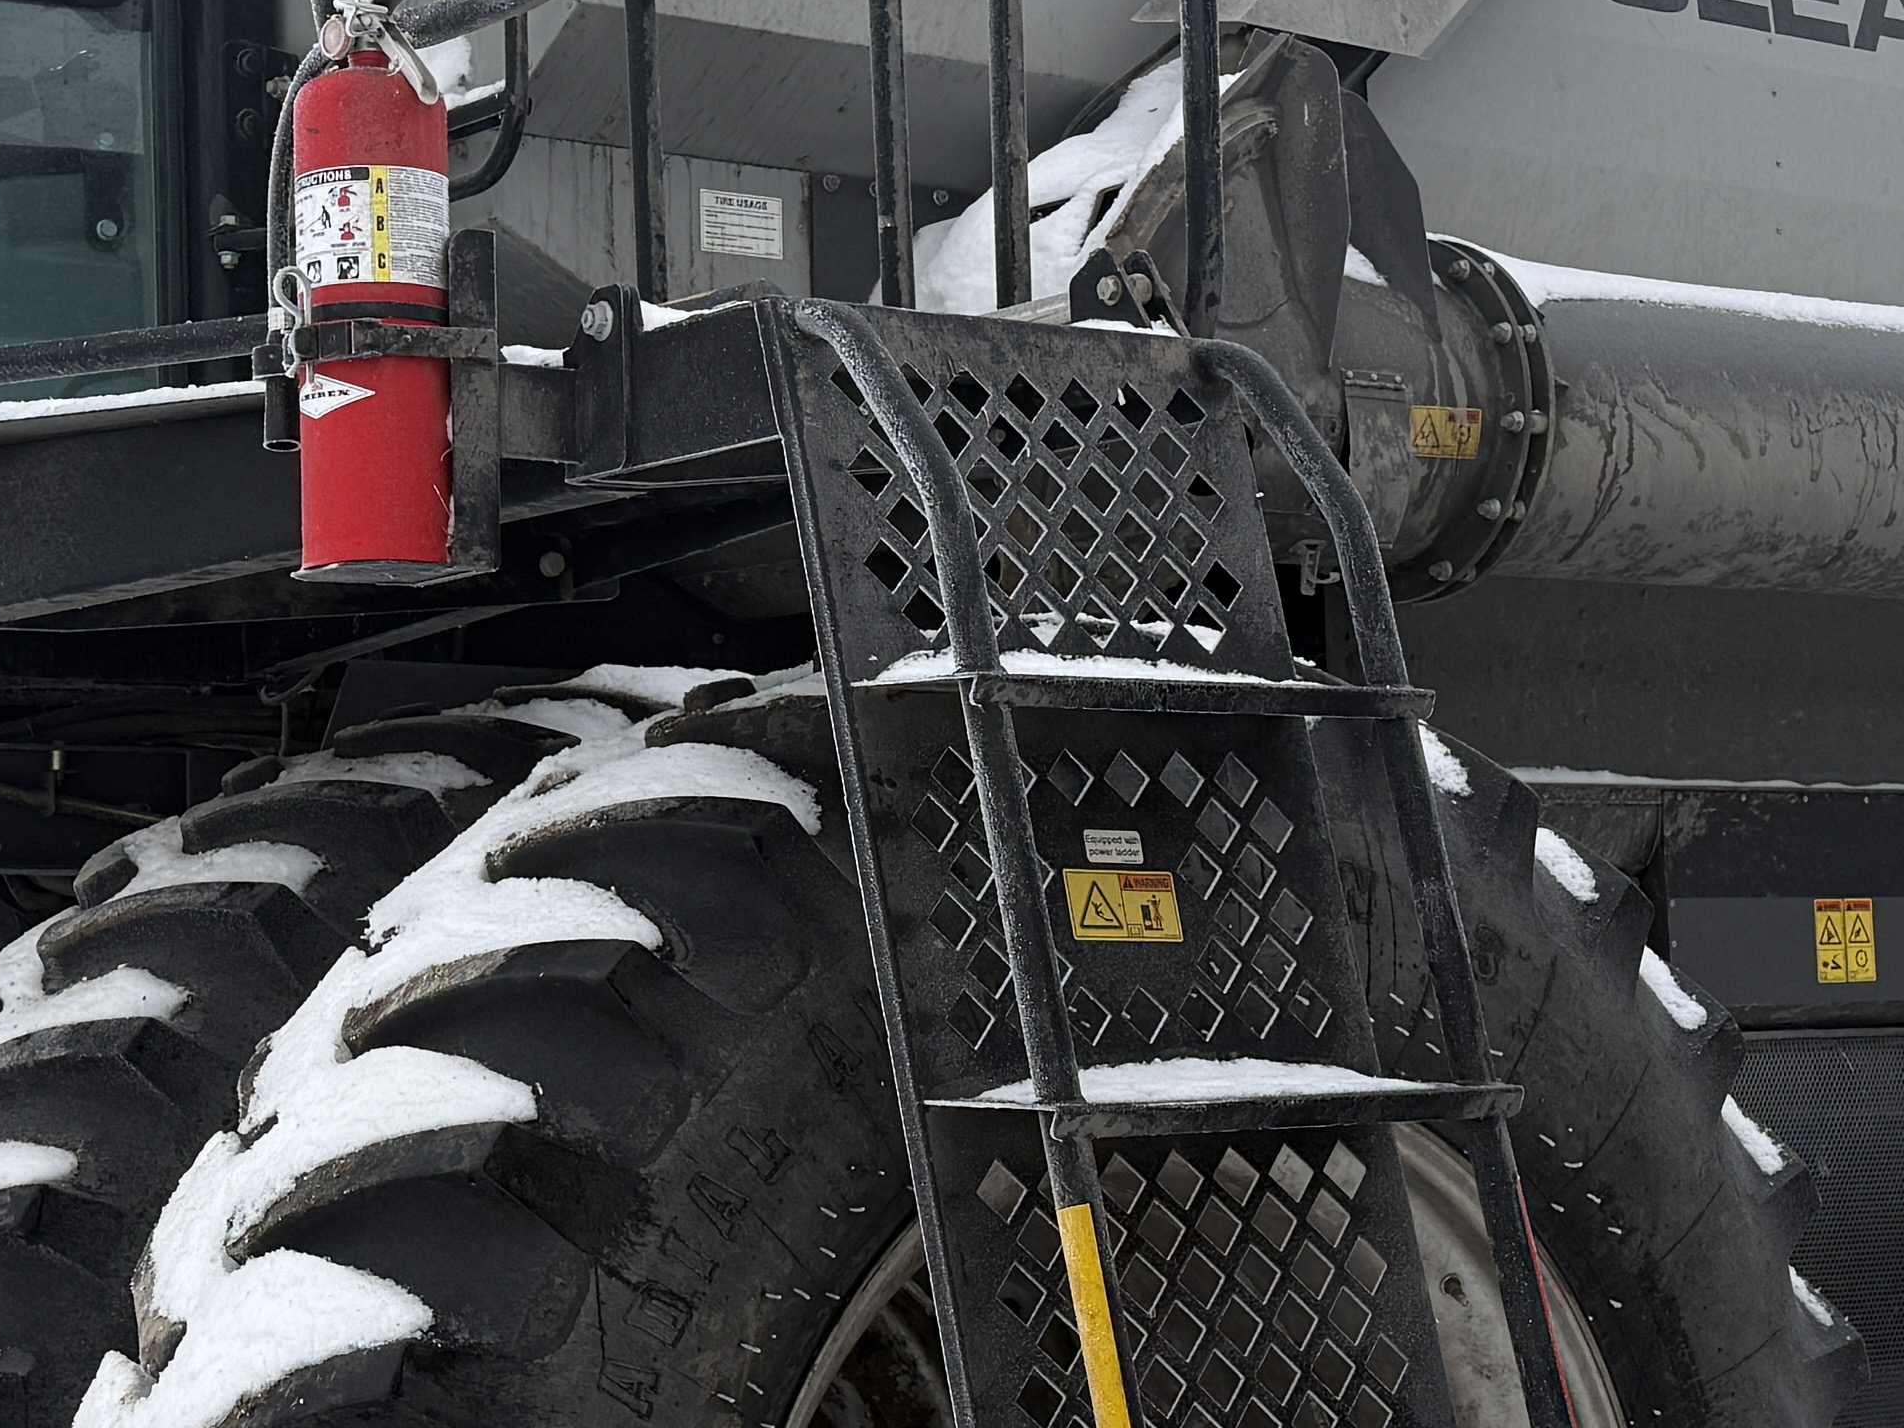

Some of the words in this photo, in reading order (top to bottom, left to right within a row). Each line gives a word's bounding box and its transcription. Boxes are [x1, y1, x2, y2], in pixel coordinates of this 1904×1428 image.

[375, 177, 384, 194] A
[376, 215, 385, 231] B
[377, 253, 386, 270] C
[1134, 877, 1170, 889] WARNING
